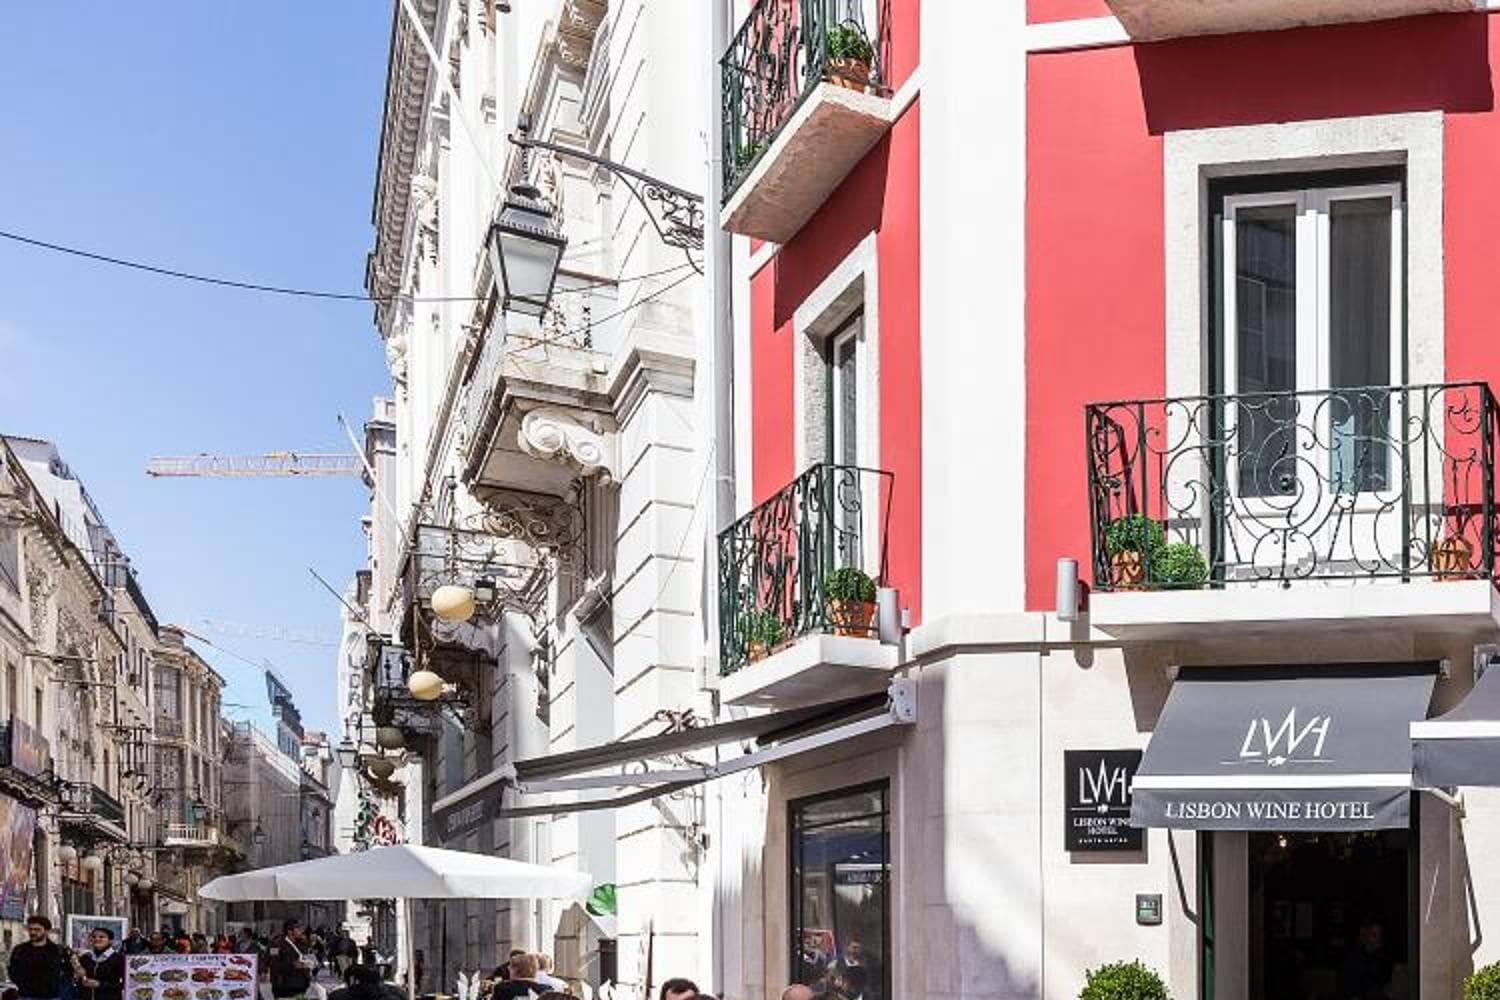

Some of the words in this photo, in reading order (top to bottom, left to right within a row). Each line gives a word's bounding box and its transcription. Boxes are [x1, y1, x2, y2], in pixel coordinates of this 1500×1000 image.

[1165, 801, 1240, 819] LISBON
[1247, 800, 1301, 819] WINE
[1305, 800, 1376, 819] HOTEL
